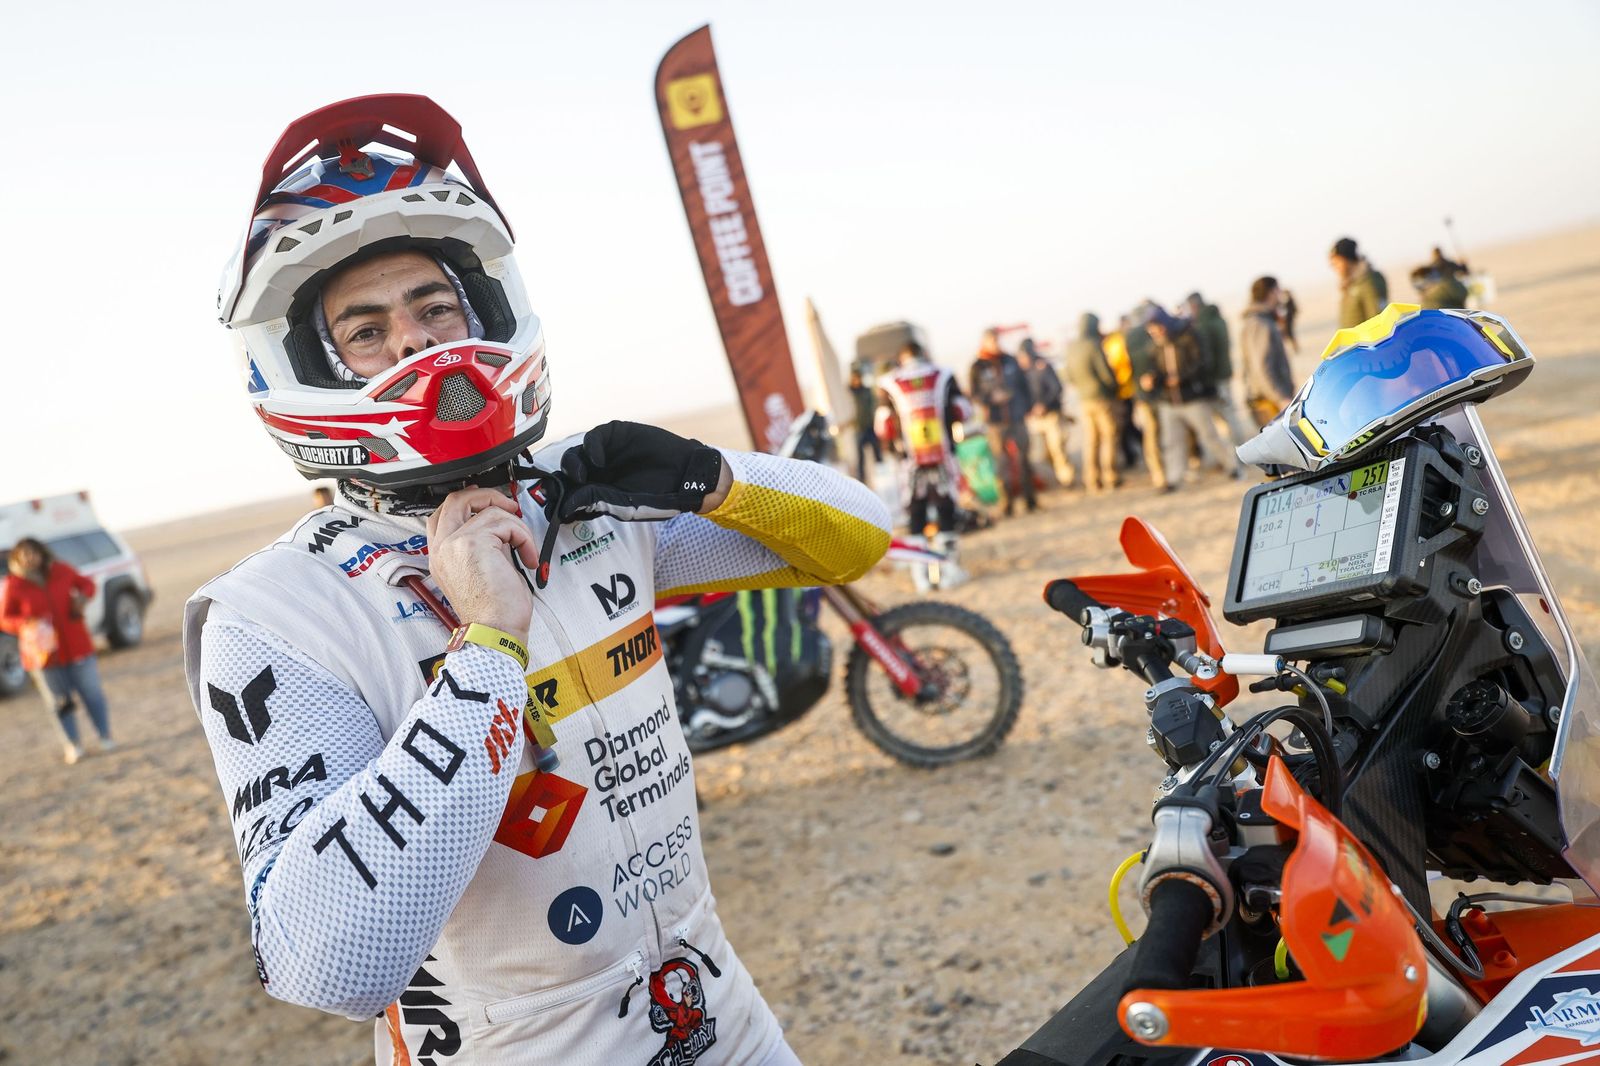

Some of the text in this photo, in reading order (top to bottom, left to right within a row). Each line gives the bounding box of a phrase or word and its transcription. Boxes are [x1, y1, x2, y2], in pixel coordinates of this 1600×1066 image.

[688, 140, 764, 306] COFFEE POINT
[299, 445, 349, 465] DOCHERTY
[1362, 463, 1386, 488] 257
[606, 625, 658, 677] THOR
[584, 695, 671, 766] Diamond
[594, 735, 668, 792] Global
[233, 753, 327, 823] MIRA
[600, 753, 690, 822] Terminals
[613, 816, 692, 893] ACCESS
[615, 852, 691, 919] WORLD
